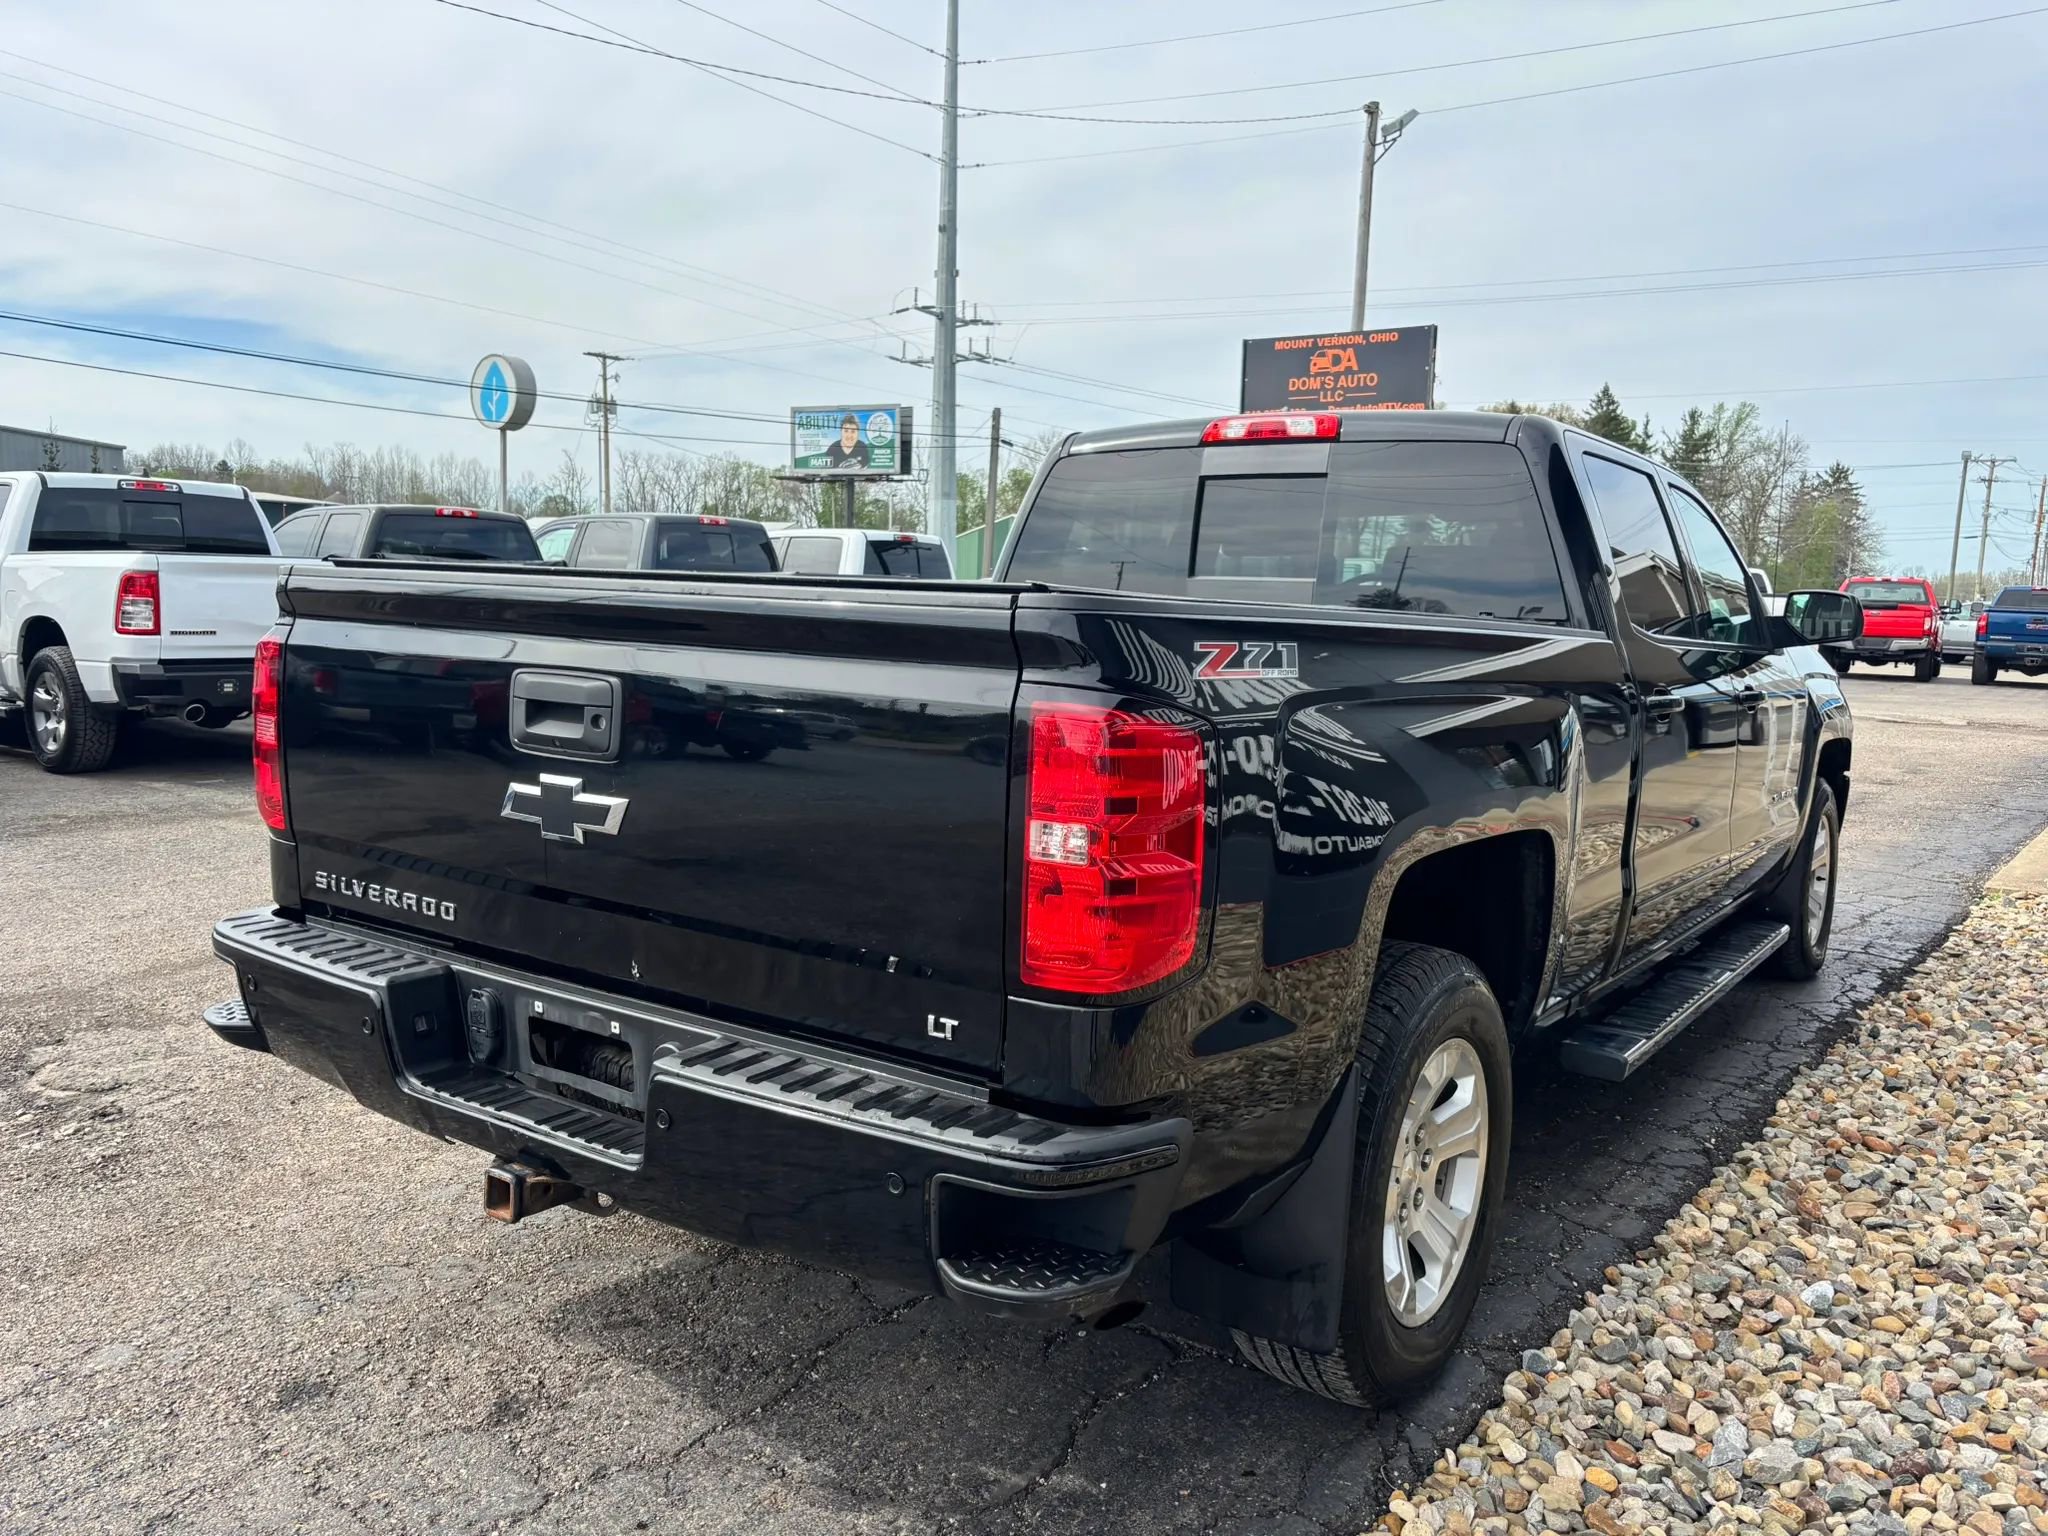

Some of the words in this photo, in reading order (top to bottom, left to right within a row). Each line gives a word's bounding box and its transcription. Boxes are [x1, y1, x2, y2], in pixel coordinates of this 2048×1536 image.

[1275, 338, 1314, 350] MOUNT
[1317, 334, 1366, 347] VERNON,
[1369, 332, 1398, 343] OHIO
[1288, 376, 1334, 391] DOM'S
[1337, 373, 1378, 387] AUTO
[1320, 390, 1344, 402] LLC
[797, 414, 839, 431] ABILITY
[1193, 642, 1298, 679] Z71
[1277, 669, 1298, 677] ROAD
[315, 871, 456, 921] SILVERADO
[928, 1014, 960, 1040] LT
